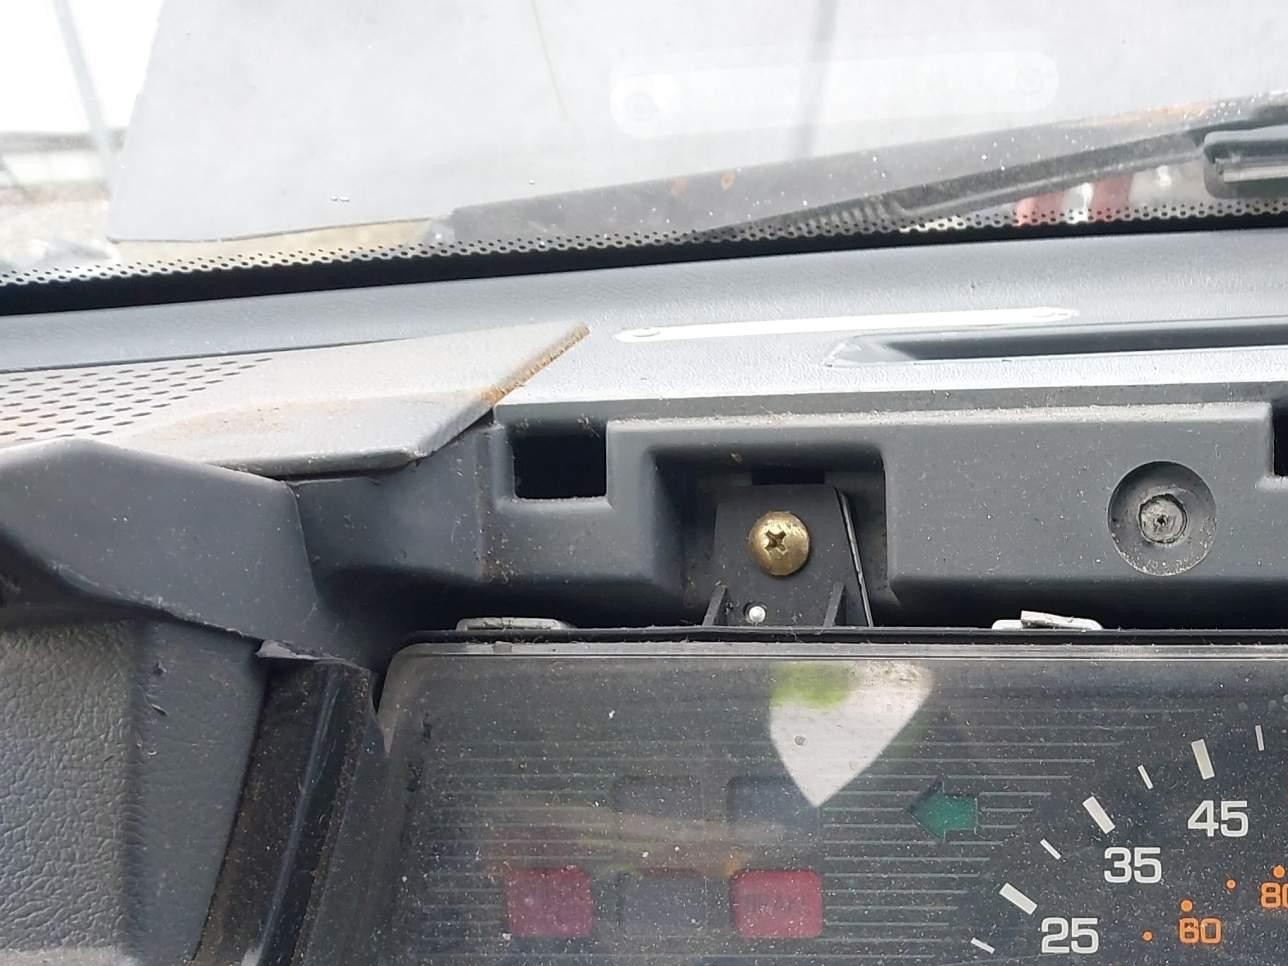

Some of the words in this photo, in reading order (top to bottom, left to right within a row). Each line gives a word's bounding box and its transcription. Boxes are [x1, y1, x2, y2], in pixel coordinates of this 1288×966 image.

[1187, 799, 1249, 838] 45
[1103, 846, 1162, 884] 35
[1040, 917, 1099, 954] 25
[1178, 917, 1222, 945] 60
